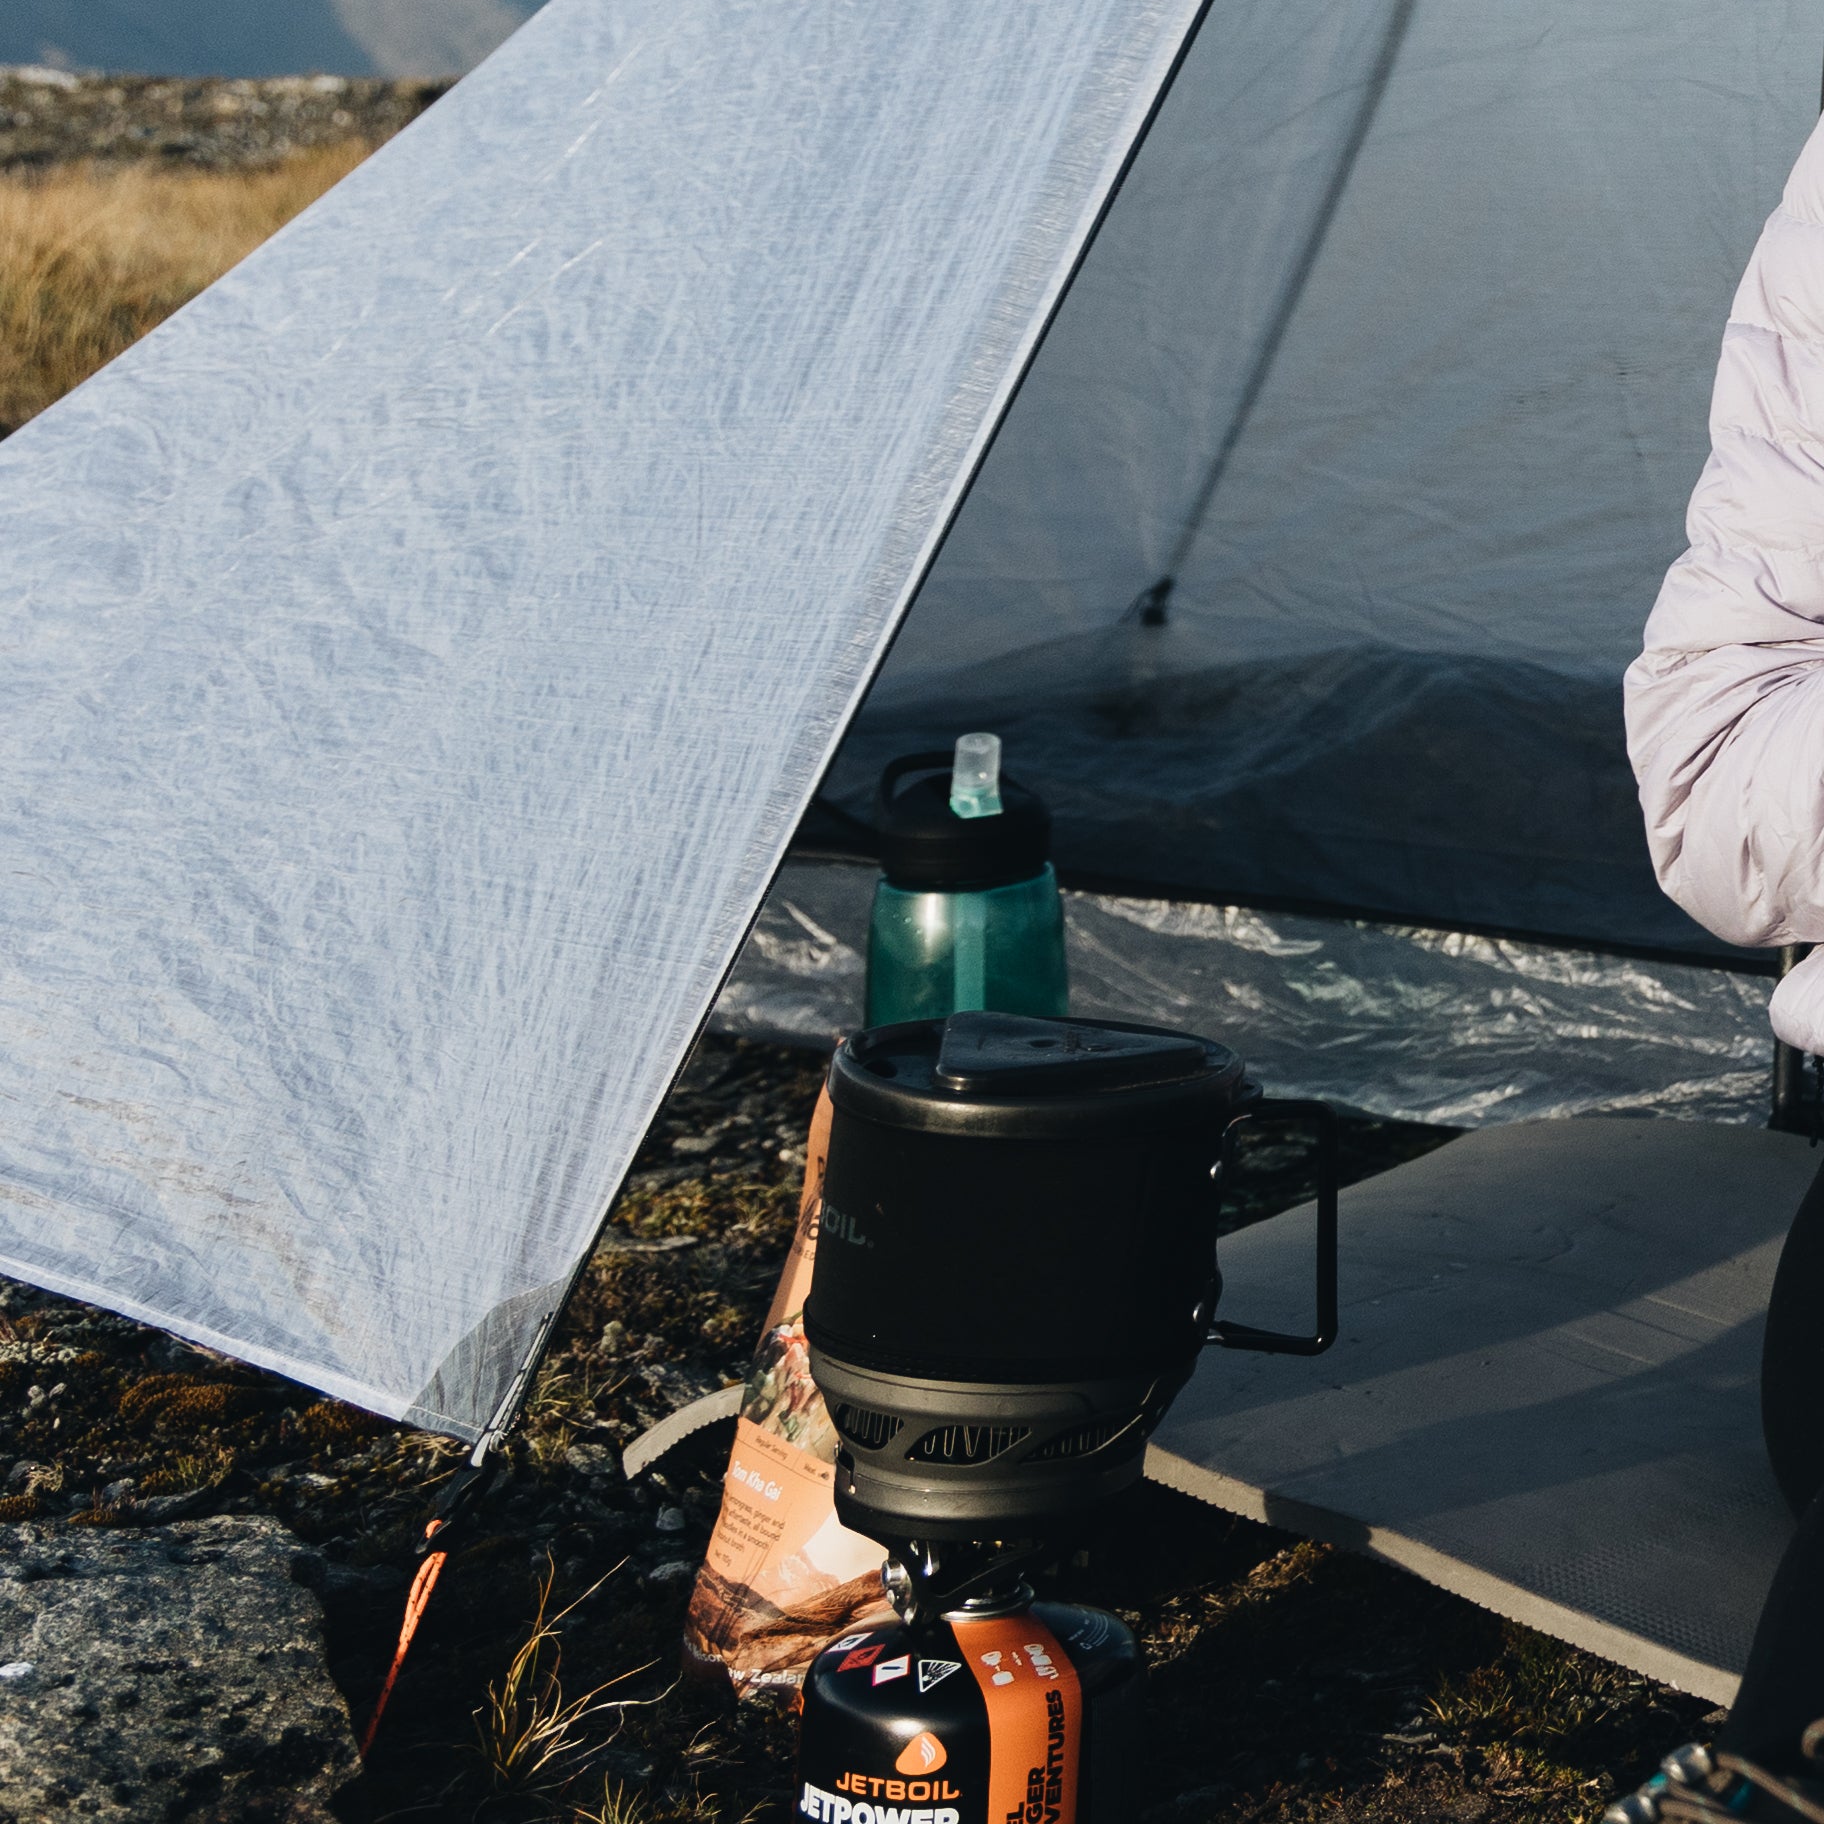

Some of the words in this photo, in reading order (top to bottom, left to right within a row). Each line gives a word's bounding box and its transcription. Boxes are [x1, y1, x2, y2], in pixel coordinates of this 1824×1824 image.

[732, 1460, 747, 1482] Tom
[764, 1479, 784, 1503] Gai
[835, 1771, 961, 1801] JETBOIL
